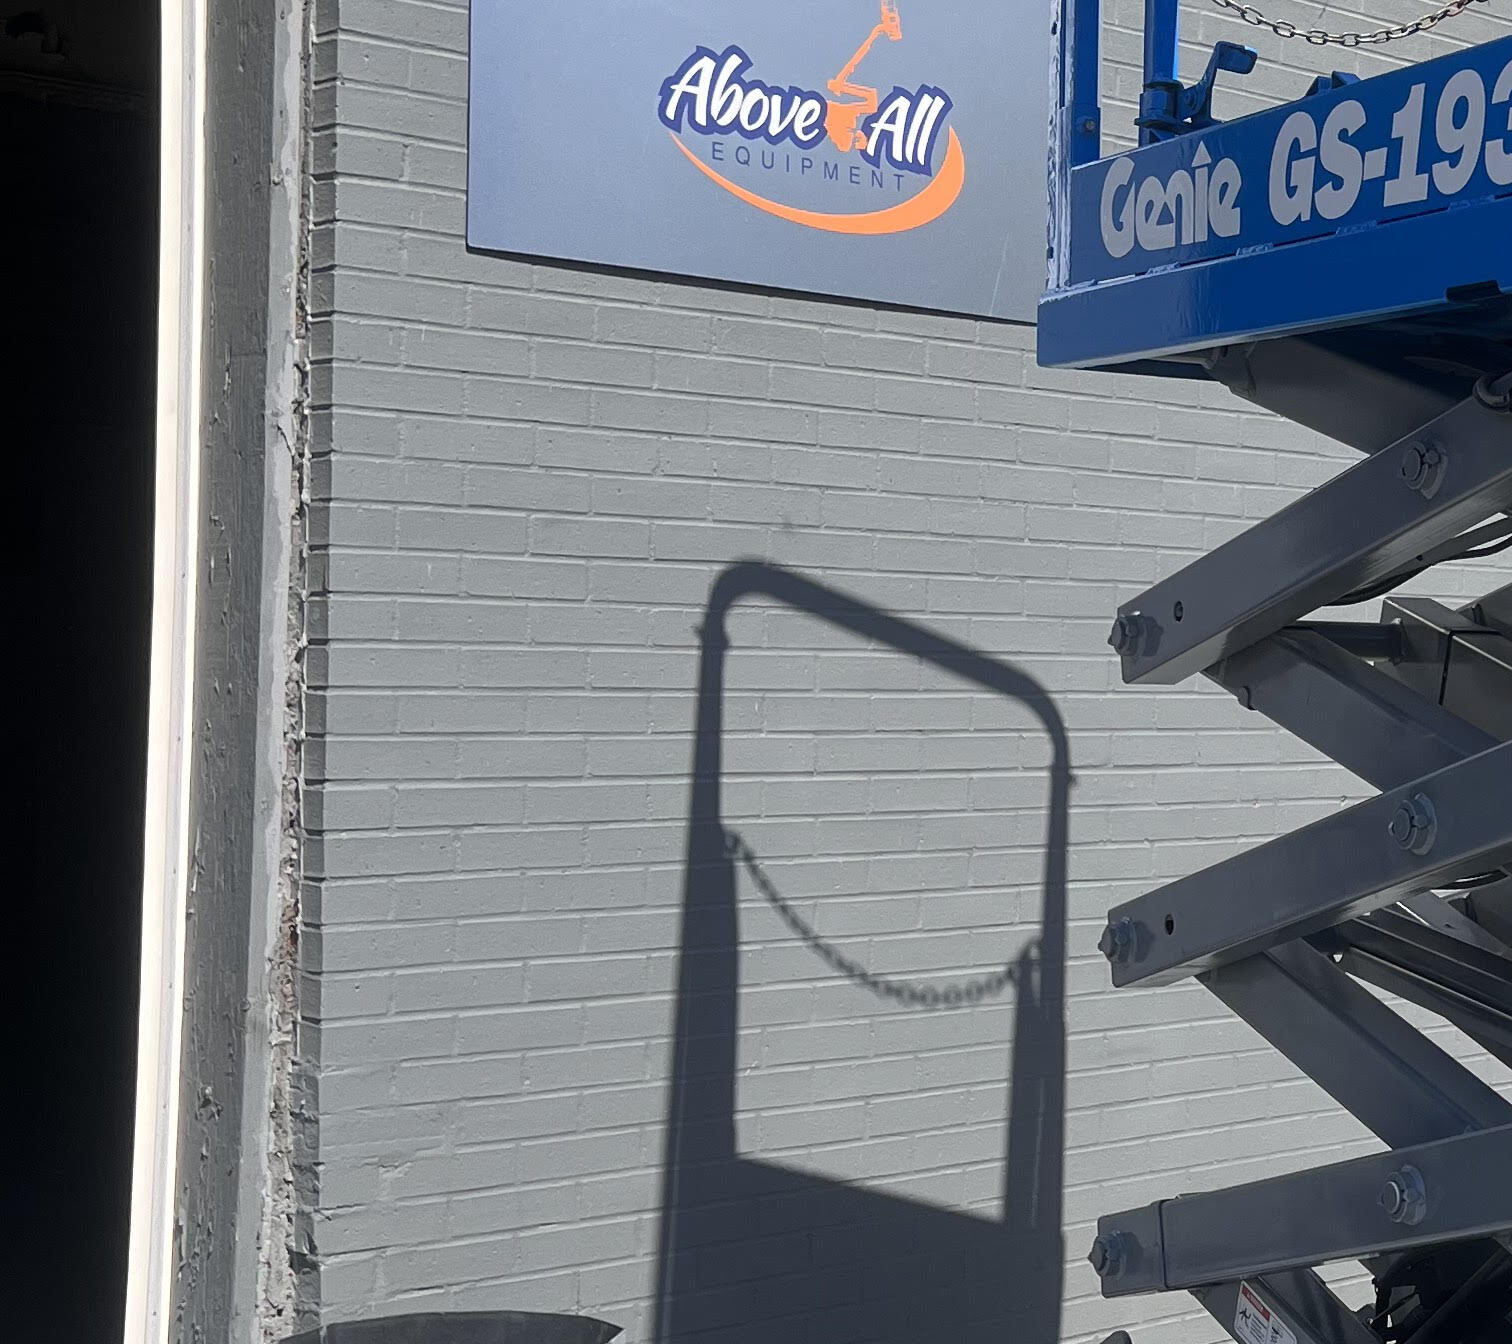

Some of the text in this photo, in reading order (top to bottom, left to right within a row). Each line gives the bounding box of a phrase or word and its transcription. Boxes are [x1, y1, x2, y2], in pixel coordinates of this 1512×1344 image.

[664, 51, 947, 168] Above All
[710, 140, 906, 192] EQUIPMENT
[1099, 140, 1242, 258] Genie
